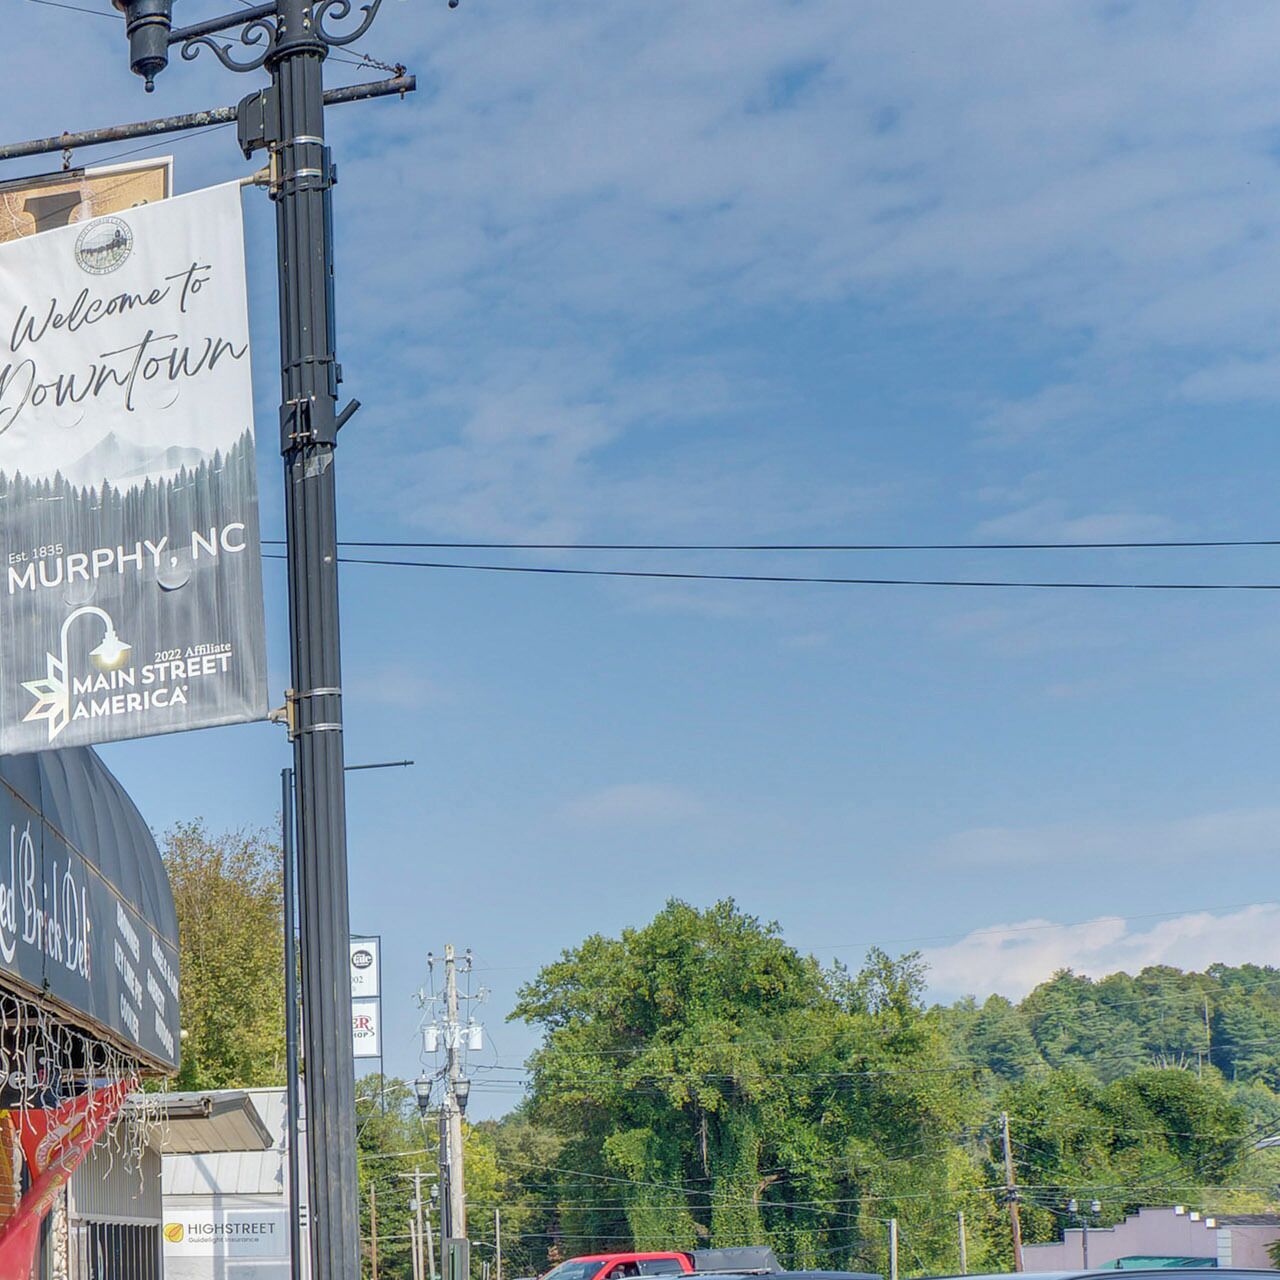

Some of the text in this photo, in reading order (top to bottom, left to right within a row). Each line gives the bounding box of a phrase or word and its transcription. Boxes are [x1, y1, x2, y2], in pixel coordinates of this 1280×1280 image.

[10, 262, 211, 352] Welcome to
[8, 522, 246, 594] MURPHY, NC
[33, 543, 64, 559] 1835
[73, 652, 232, 695] MAIN STREET
[155, 642, 231, 663] 2022 Affiliate
[19, 820, 63, 963] Brick
[62, 857, 92, 981] Deli
[188, 1222, 275, 1235] HIGHSTREET
